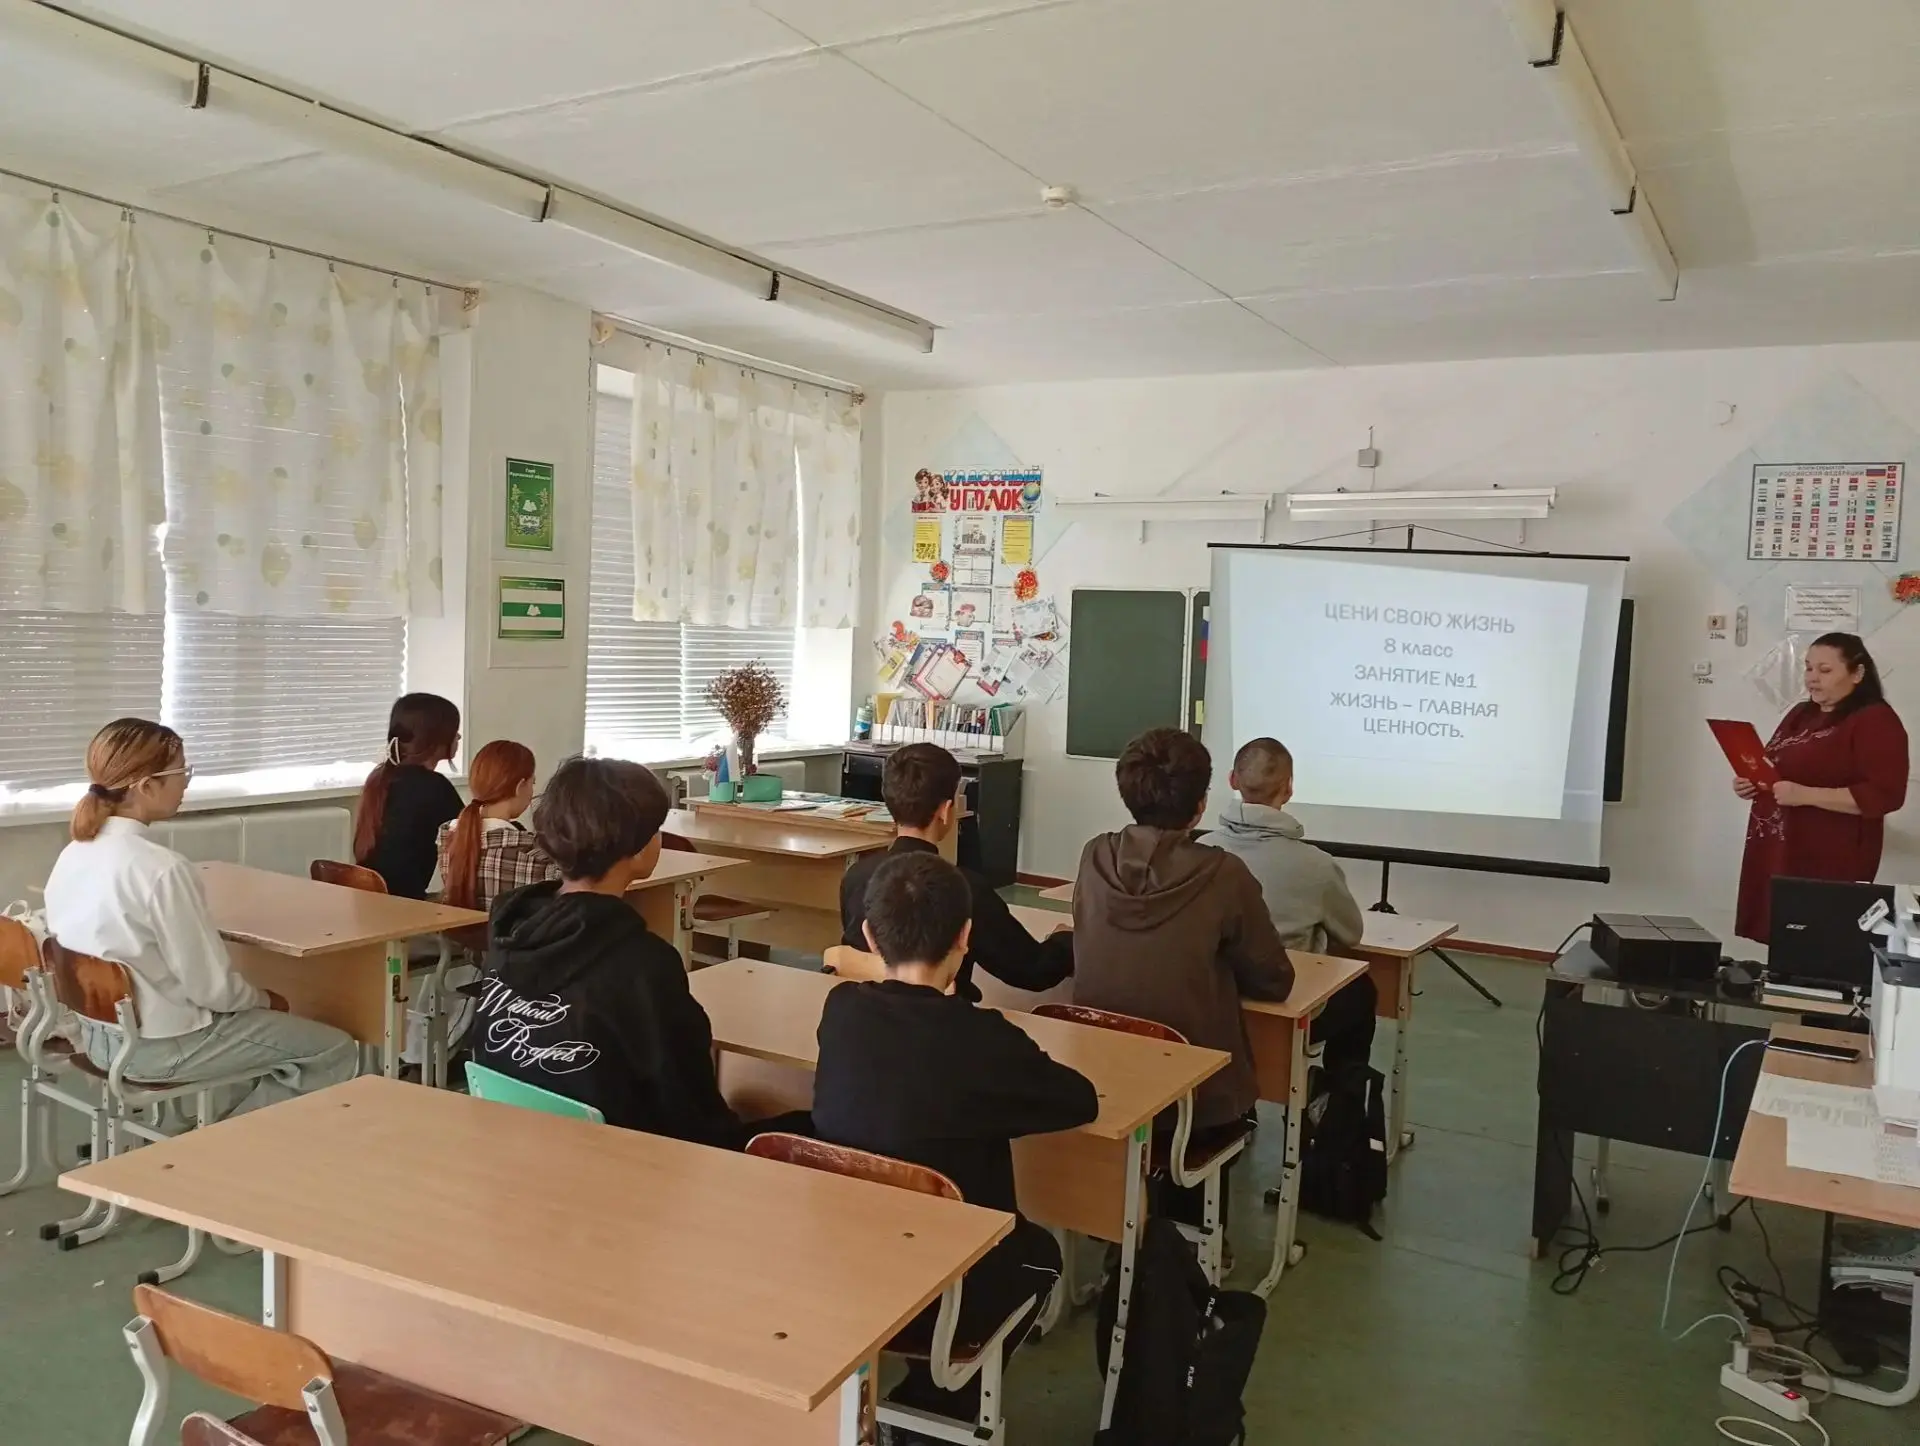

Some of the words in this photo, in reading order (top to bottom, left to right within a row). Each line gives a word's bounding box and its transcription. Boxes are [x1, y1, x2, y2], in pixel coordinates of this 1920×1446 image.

[944, 469, 1041, 487] КЛАССНЫЙ
[950, 489, 1024, 511] УГОЛОК
[1325, 603, 1378, 622] ЦЕНИ
[1383, 607, 1442, 627] СВОЮ
[1446, 613, 1515, 633] ЖИЗНЬ
[1384, 638, 1396, 653] 8
[1402, 643, 1454, 657] класс
[1354, 664, 1440, 686] ЗАНЯТИЕ
[1446, 672, 1477, 688] №1
[1330, 692, 1398, 710] ЖИЗНЬ
[1419, 699, 1498, 717] ГЛАВНАЯ
[1364, 717, 1464, 738] ЦЕННОСТЬ.
[476, 974, 571, 1026] Without
[485, 1018, 600, 1074] Regrets
